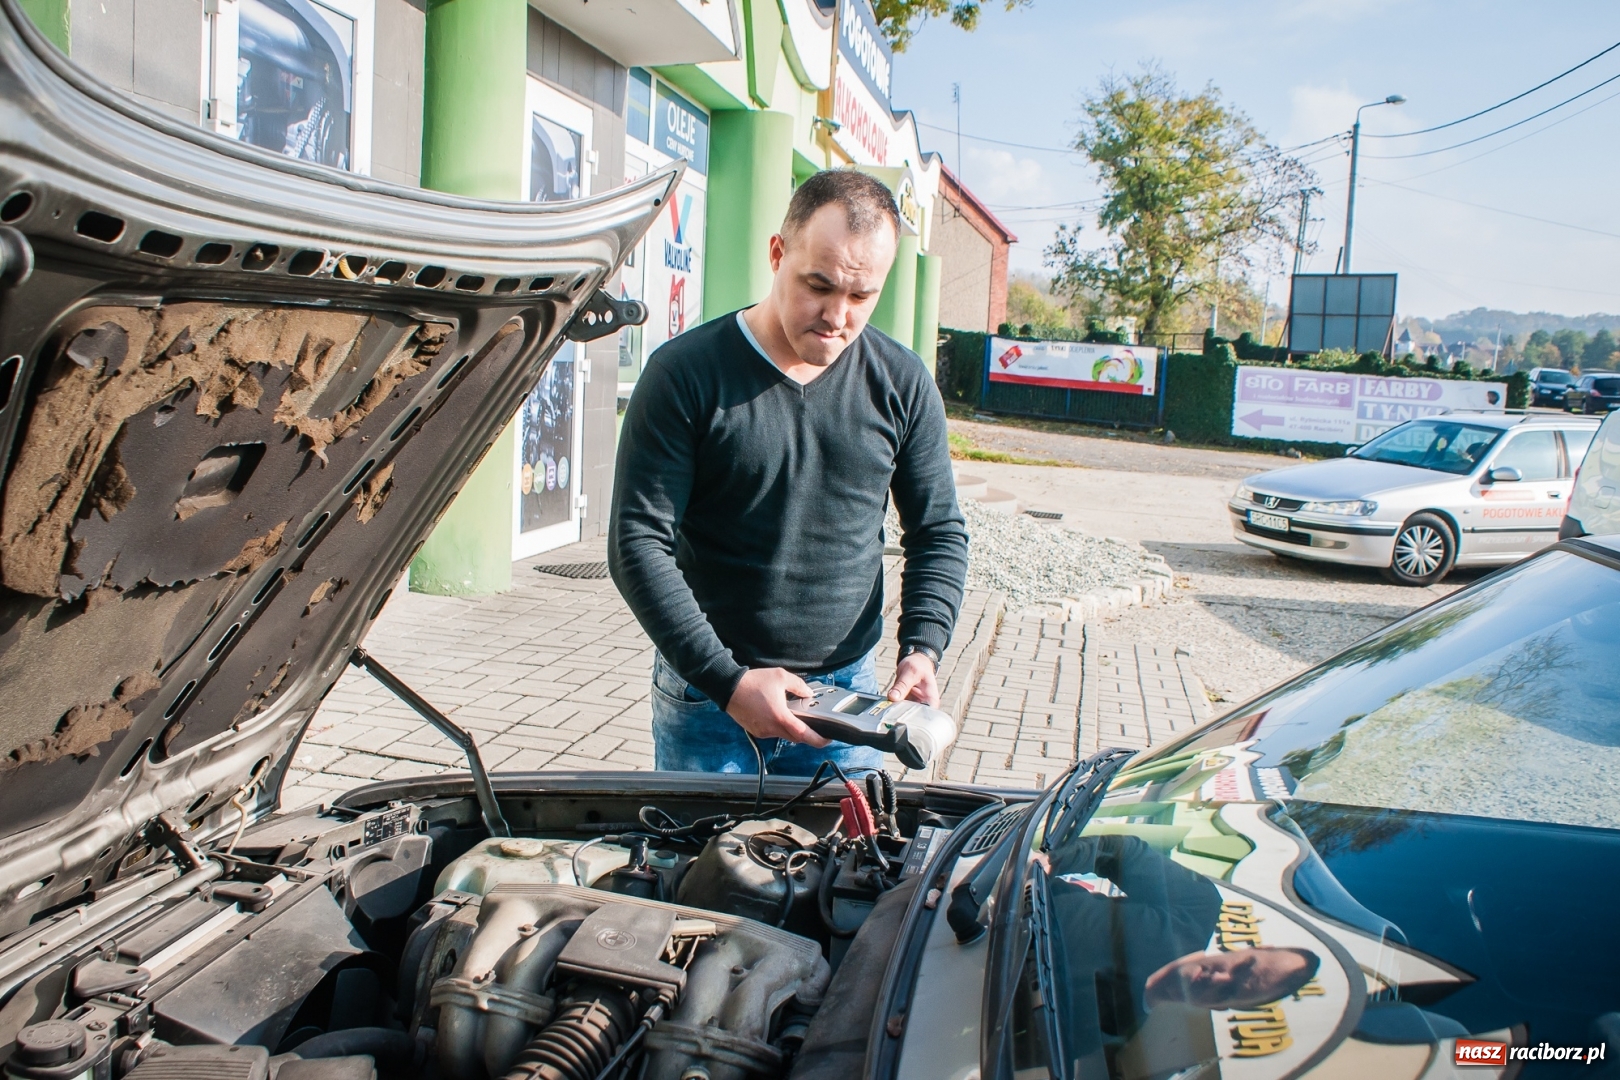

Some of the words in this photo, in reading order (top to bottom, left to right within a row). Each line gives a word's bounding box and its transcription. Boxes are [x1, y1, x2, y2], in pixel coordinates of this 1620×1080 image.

[842, 0, 890, 99] POGOTOWIE
[667, 101, 697, 146] OLEJE
[834, 76, 888, 166] ALKOHOLOWE
[666, 135, 678, 153] CENY
[664, 238, 693, 274] VALVOLINE
[1293, 376, 1351, 395] FARB
[1364, 379, 1433, 399] FARBY
[1482, 508, 1543, 519] POGOTOWIE
